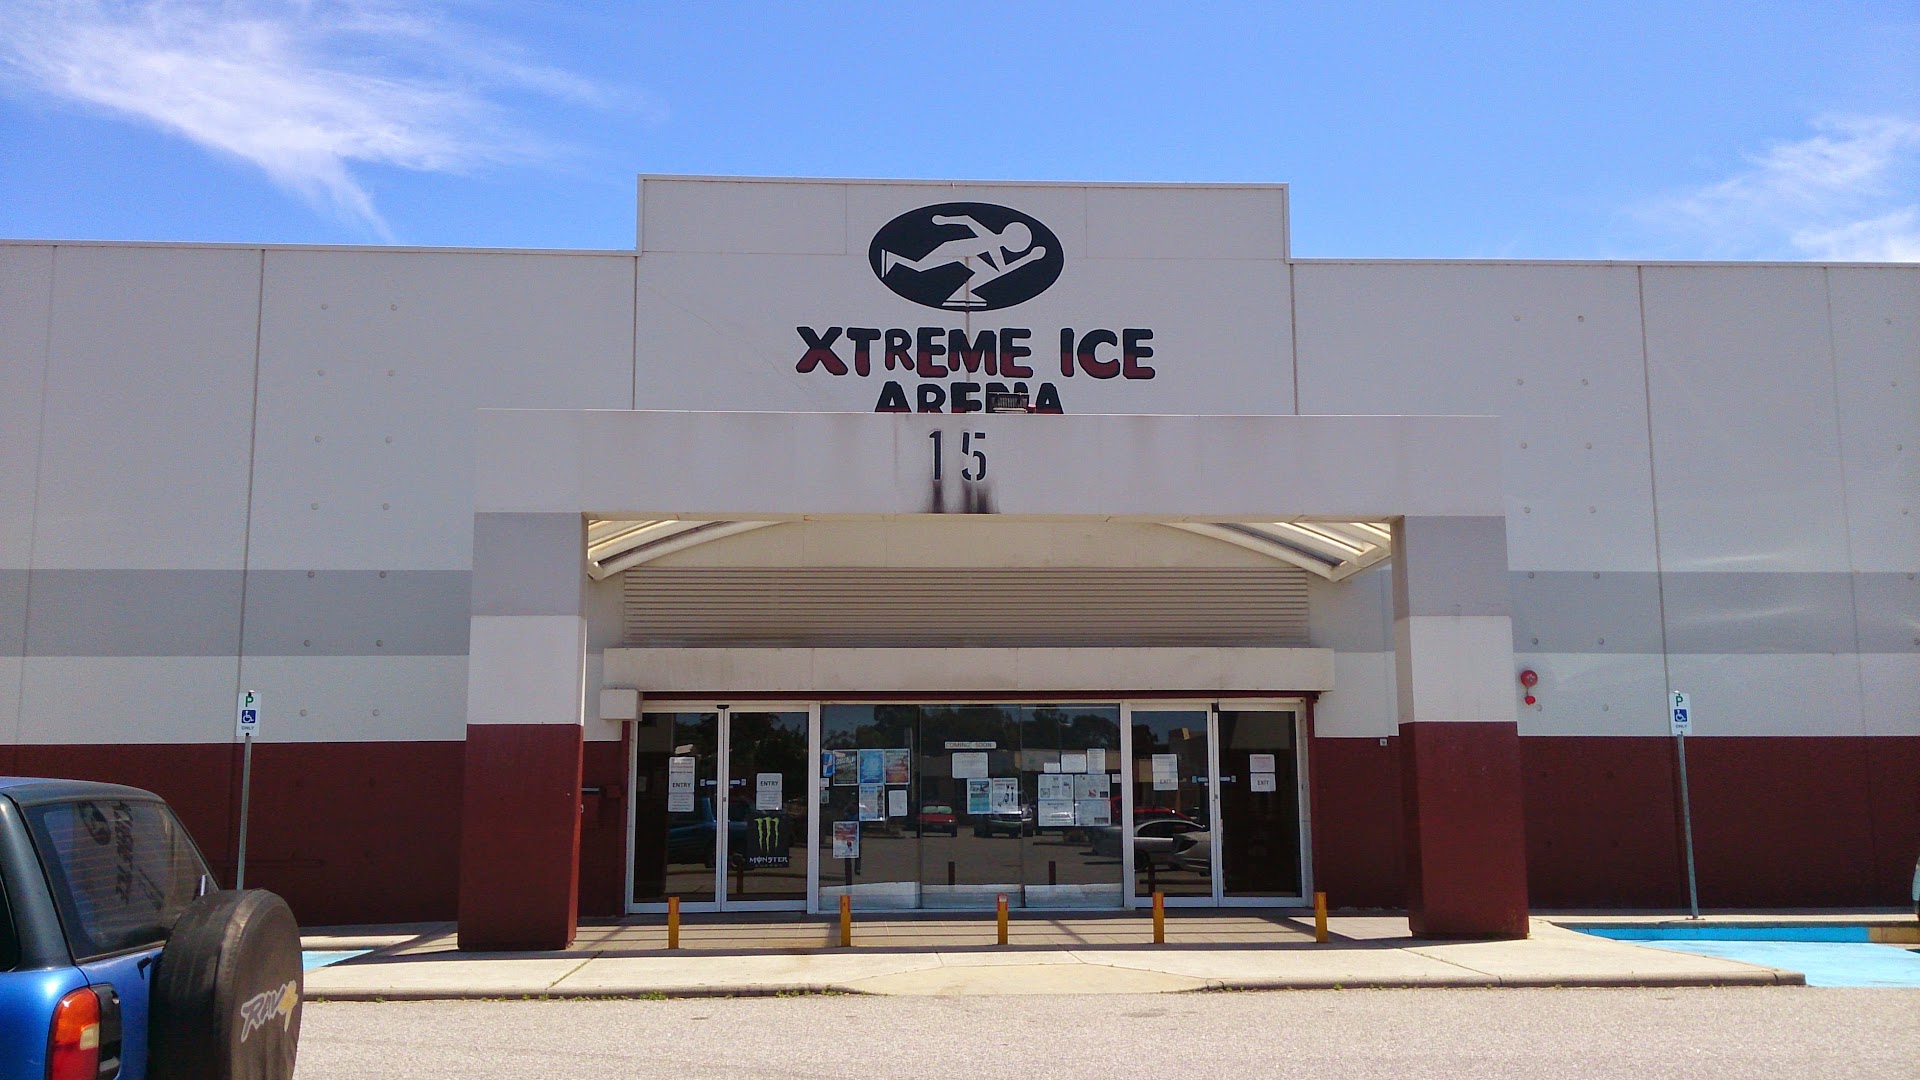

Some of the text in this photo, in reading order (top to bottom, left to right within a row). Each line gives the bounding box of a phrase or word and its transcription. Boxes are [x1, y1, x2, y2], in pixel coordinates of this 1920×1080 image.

[795, 326, 1156, 380] XTREME ICE
[928, 430, 987, 482] 15
[245, 695, 254, 707] P
[1675, 695, 1684, 707] P
[749, 855, 789, 864] MONSTER
[240, 979, 299, 1043] RAV4
